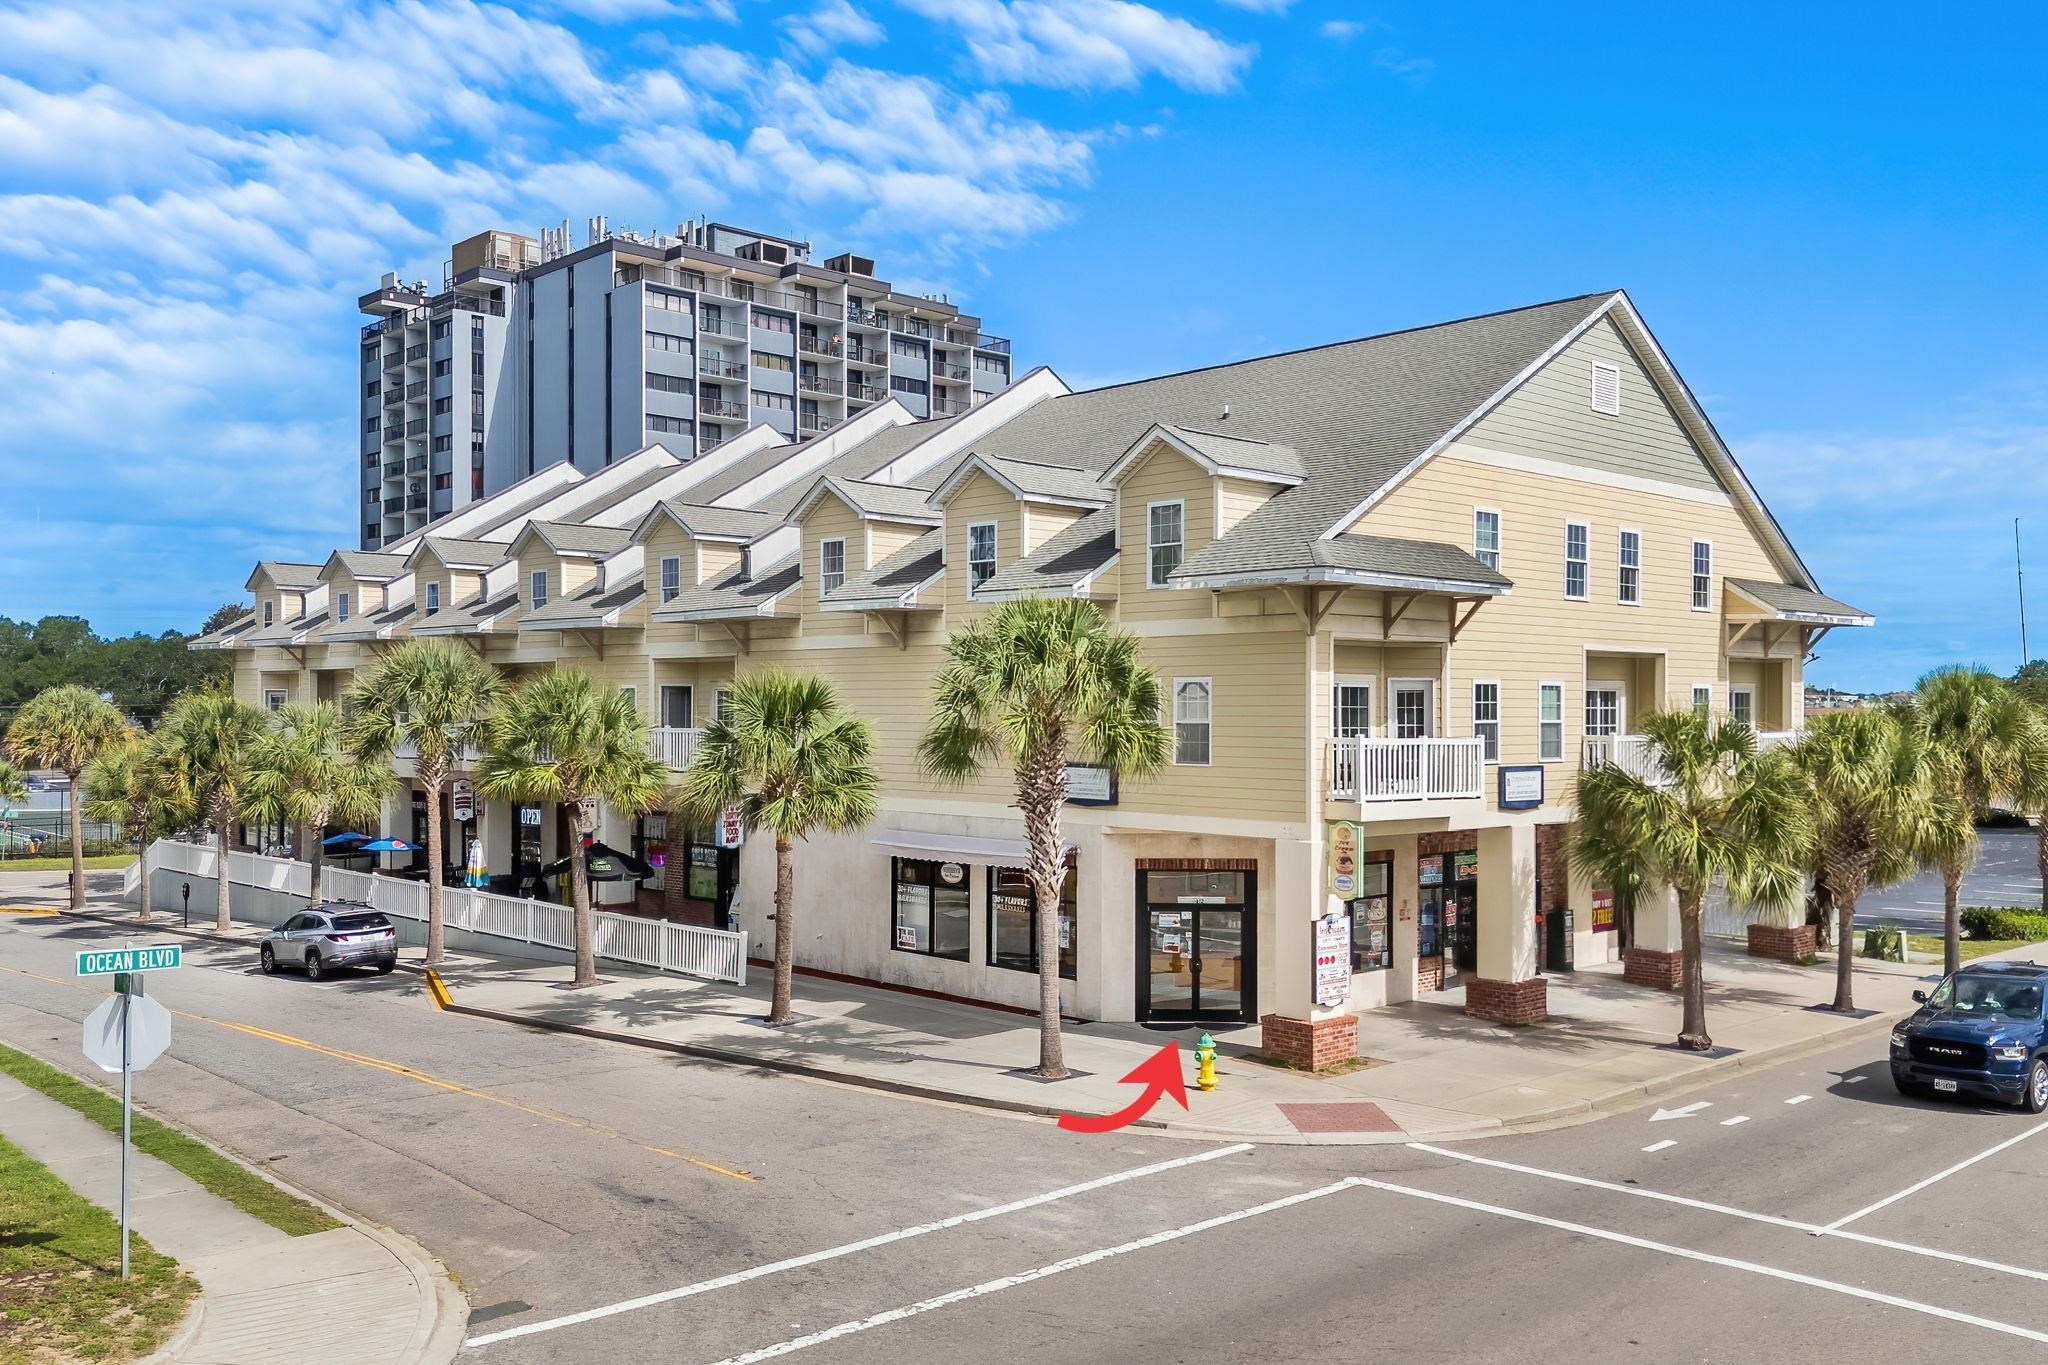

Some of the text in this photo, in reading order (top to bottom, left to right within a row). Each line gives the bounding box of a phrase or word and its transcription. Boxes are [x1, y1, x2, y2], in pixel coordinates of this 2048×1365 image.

[521, 808, 541, 824] OPEN
[726, 828, 739, 836] FOOD
[725, 836, 739, 844] MART
[1004, 896, 1029, 907] FLAVORS
[86, 949, 174, 972] OCEAN BLVD
